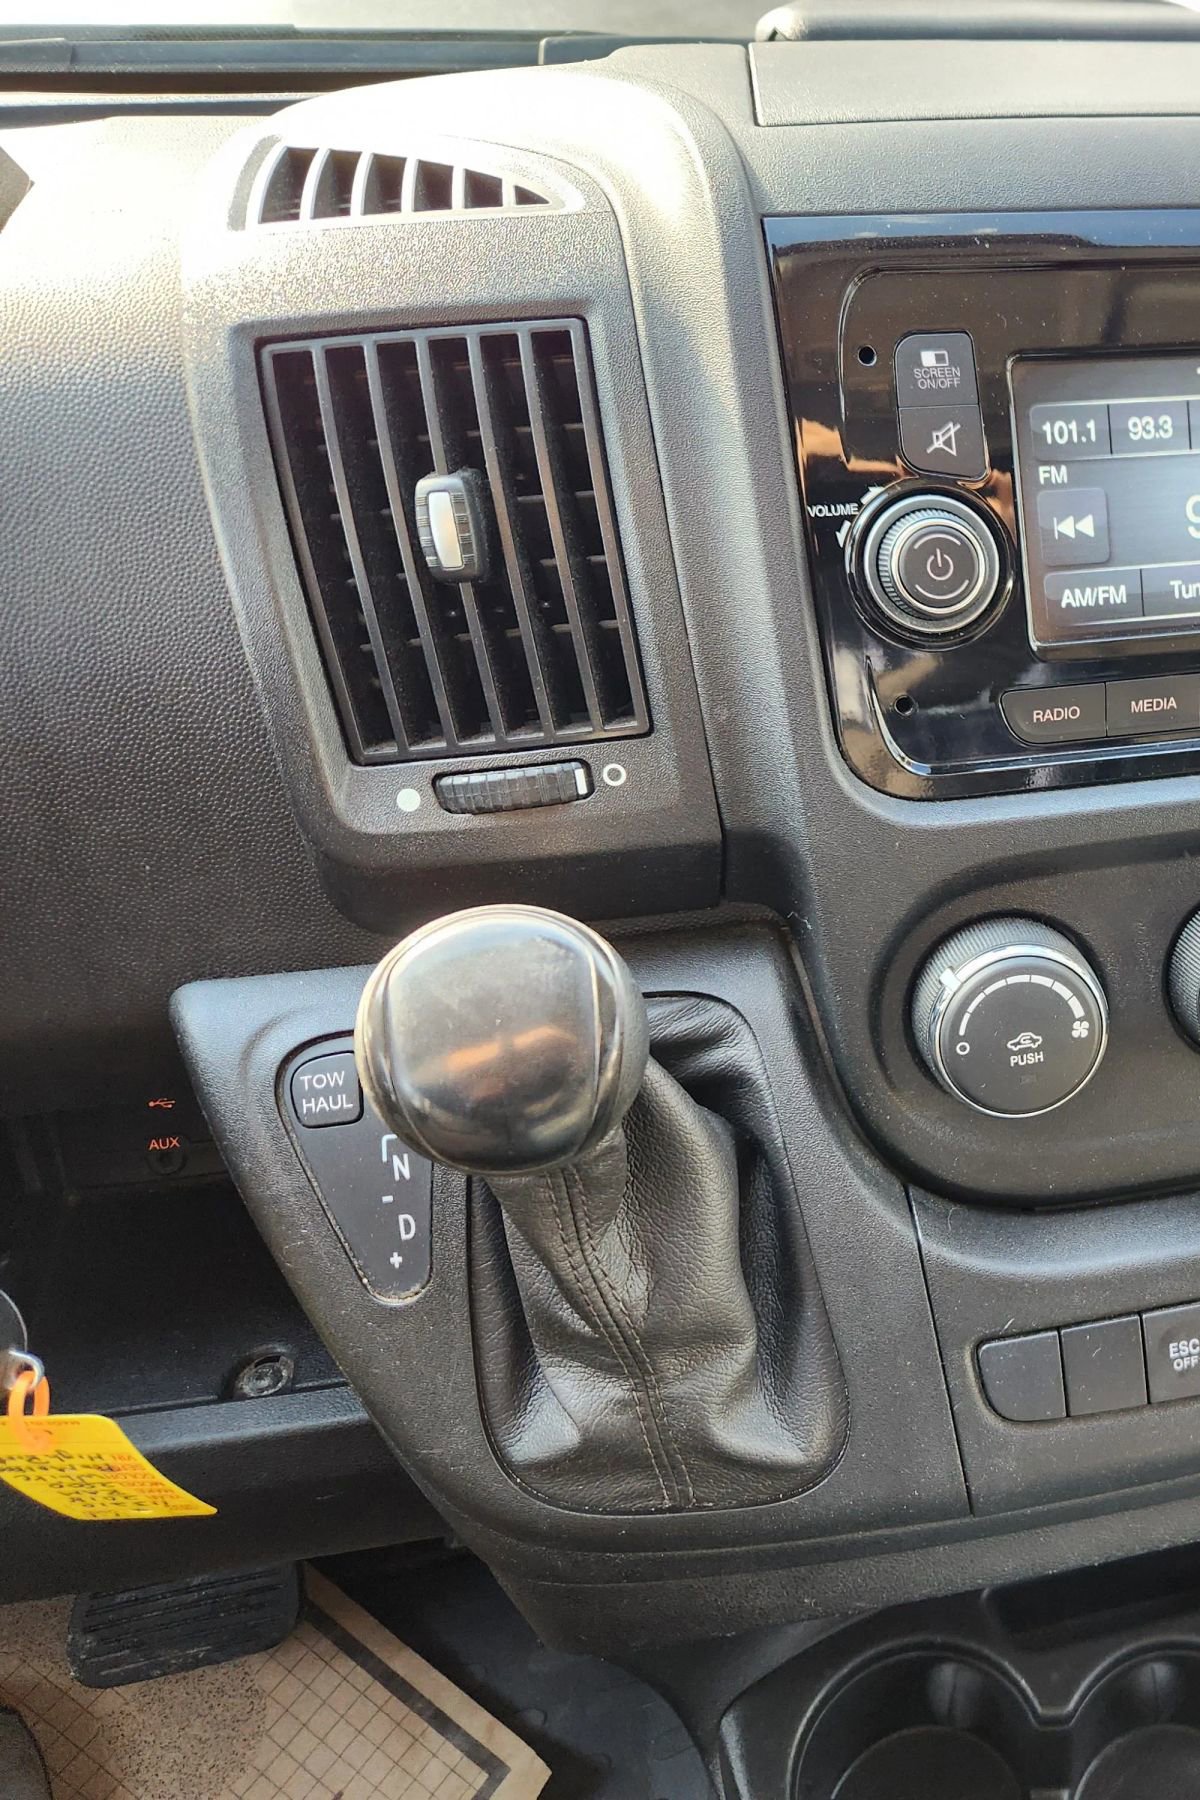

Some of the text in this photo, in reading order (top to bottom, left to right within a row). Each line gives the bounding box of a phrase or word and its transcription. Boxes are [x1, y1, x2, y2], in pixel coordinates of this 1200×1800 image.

[913, 367, 961, 379] SCREEN
[917, 377, 961, 389] ON/OFF
[1042, 419, 1097, 445] 101.1
[1128, 415, 1173, 440] 93.3
[1039, 465, 1068, 485] FM
[807, 503, 860, 517] VOLUME
[1061, 585, 1127, 609] AM/FM
[1032, 706, 1081, 723] RADIO
[1130, 697, 1178, 714] MEDIA
[1009, 1051, 1045, 1067] PUSH
[300, 1071, 345, 1090] TOW
[302, 1094, 353, 1113] HAUL
[149, 1136, 181, 1151] AUX
[391, 1153, 411, 1181] N
[398, 1213, 416, 1240] D
[1169, 1338, 1200, 1360] ESC
[1173, 1356, 1199, 1371] OFF
